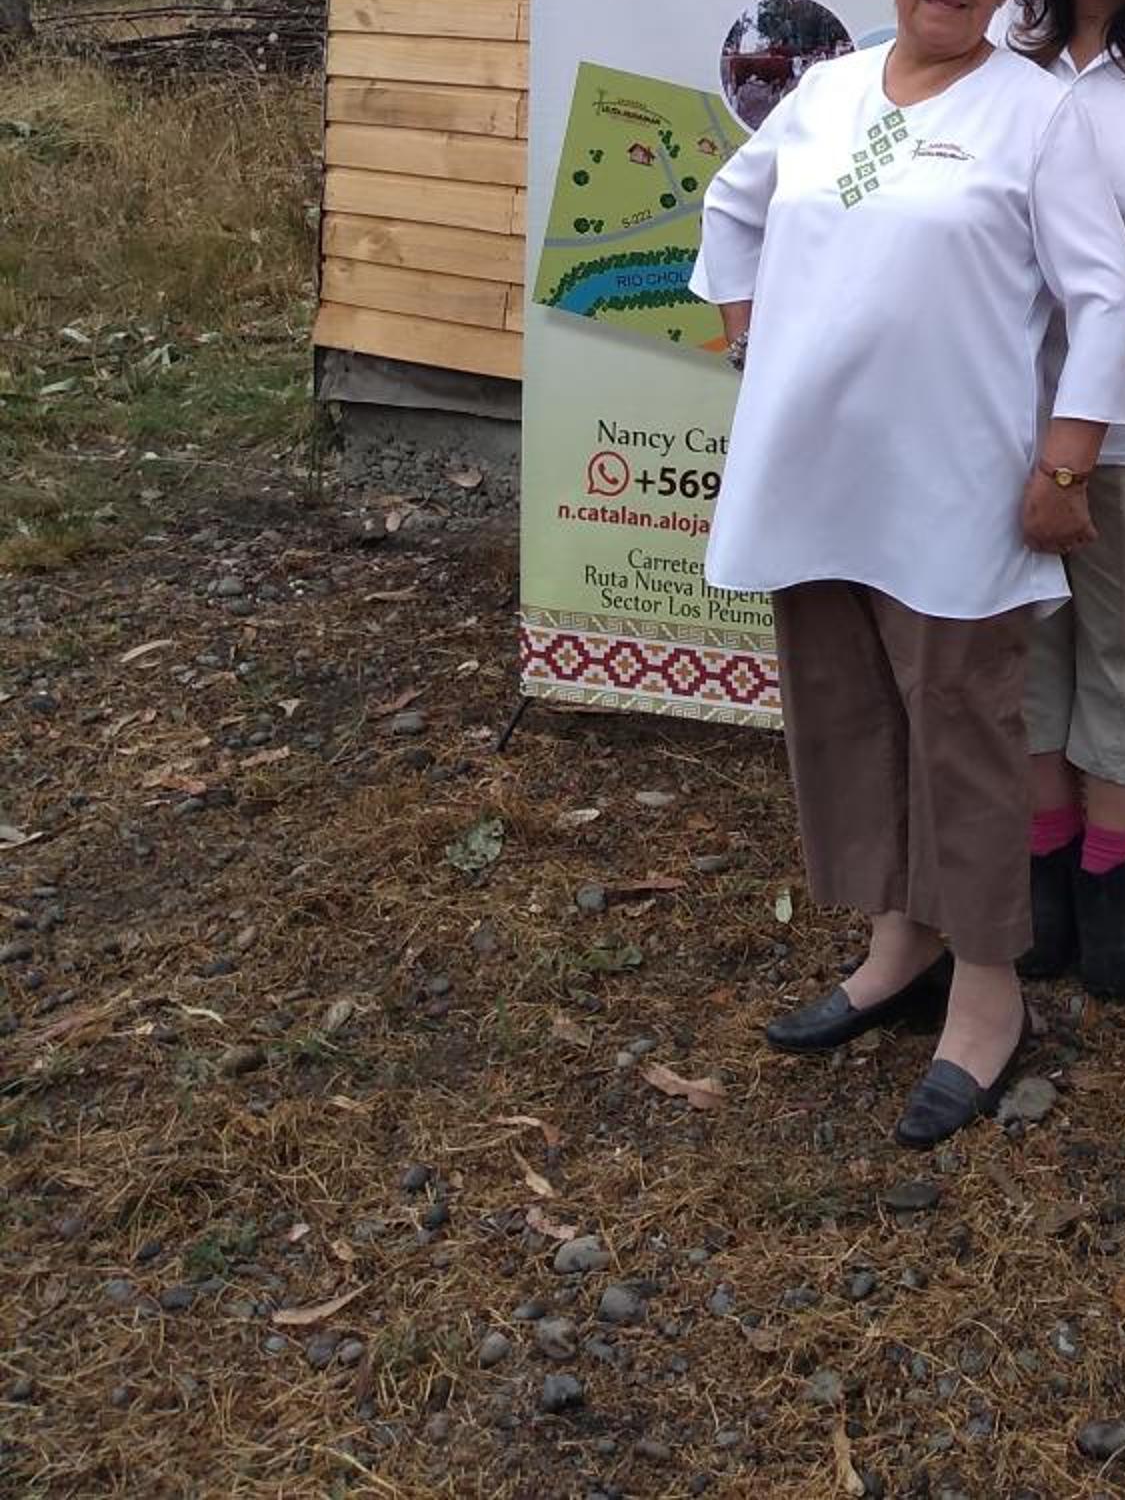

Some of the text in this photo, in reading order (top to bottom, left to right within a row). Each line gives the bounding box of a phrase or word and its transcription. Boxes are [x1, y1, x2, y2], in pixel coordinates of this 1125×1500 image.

[597, 419, 729, 457] Nancy Cat
[634, 466, 723, 500] +569
[557, 504, 711, 538] n.catalan.aloja
[584, 564, 628, 590] Ruta
[635, 570, 694, 597] Nueva
[601, 588, 773, 627] Sector Los Peumo
